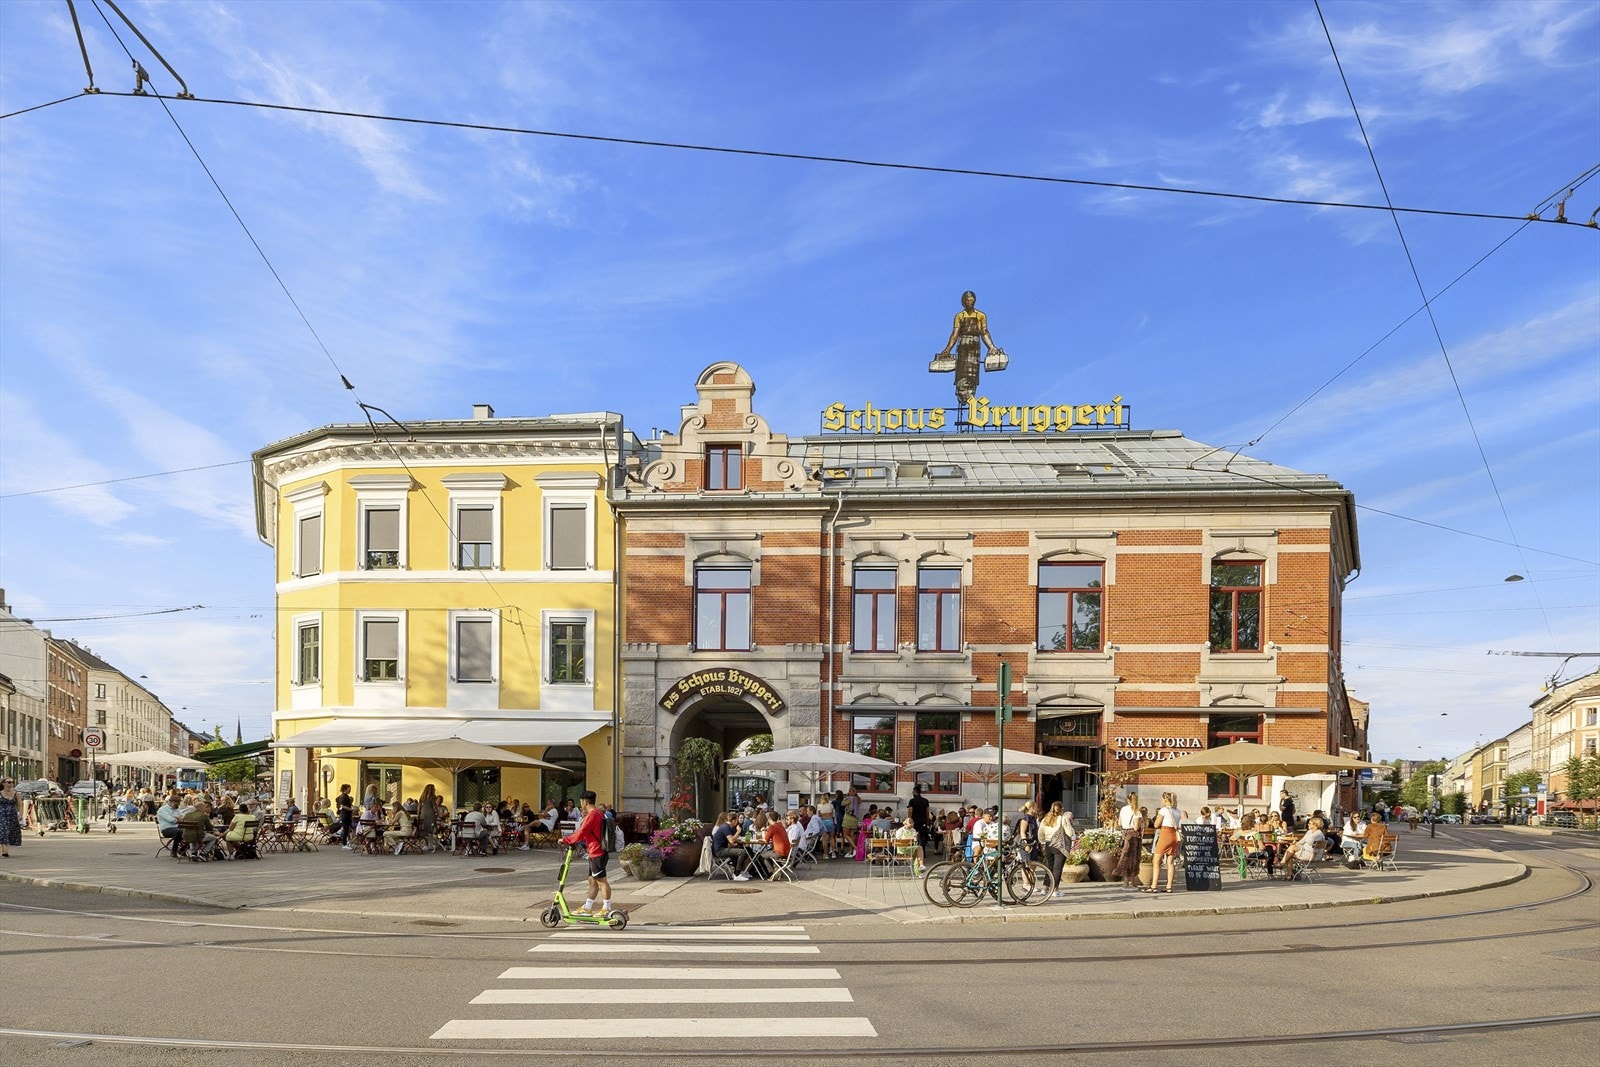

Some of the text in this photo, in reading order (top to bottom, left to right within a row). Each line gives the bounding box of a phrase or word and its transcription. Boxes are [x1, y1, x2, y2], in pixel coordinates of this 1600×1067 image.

[823, 395, 1124, 435] Schous Bryggeri
[678, 671, 726, 693] Schous
[728, 669, 783, 710] Bryggeri
[1114, 737, 1202, 748] TRATTORIA
